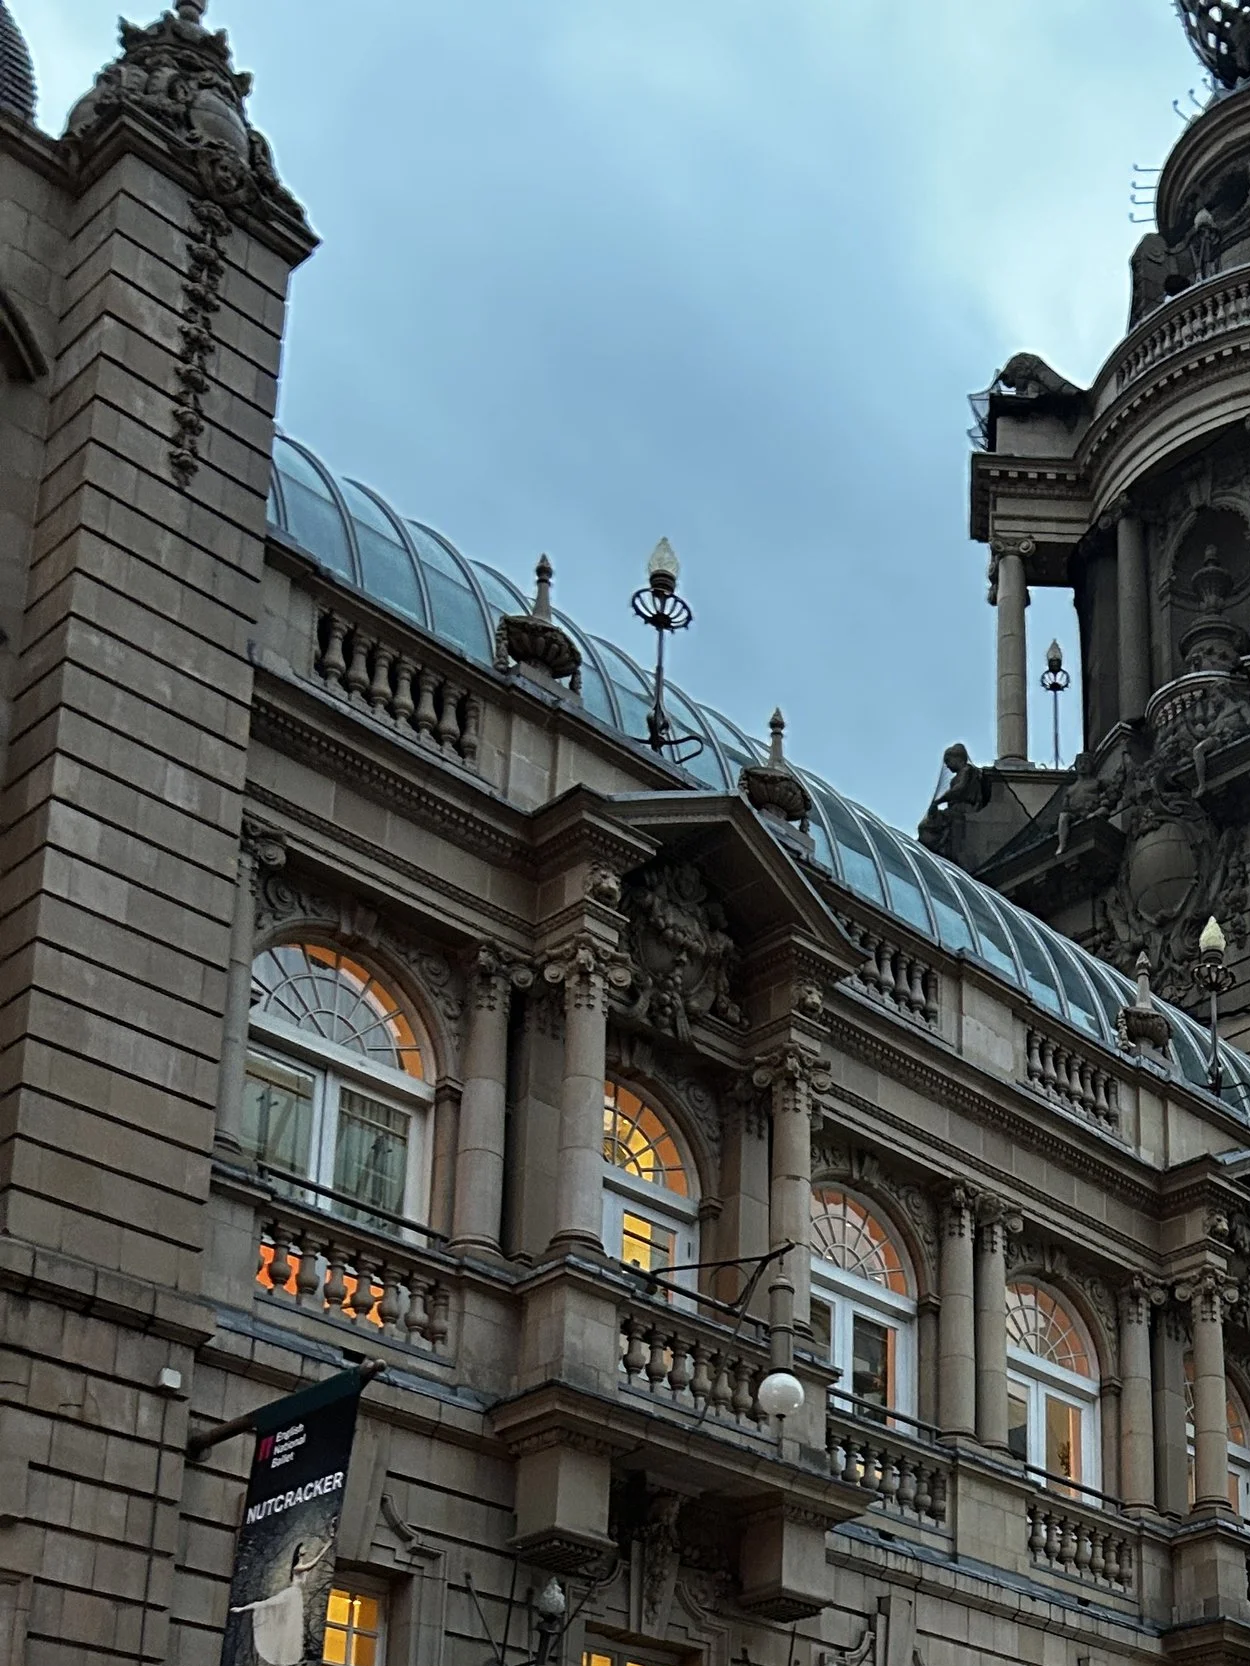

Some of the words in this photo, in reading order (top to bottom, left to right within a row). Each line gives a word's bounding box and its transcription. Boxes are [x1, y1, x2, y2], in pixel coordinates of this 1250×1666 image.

[275, 1423, 304, 1442] English
[273, 1433, 306, 1456] National
[271, 1451, 294, 1469] Ballet
[246, 1471, 344, 1524] NUTCRACKER
